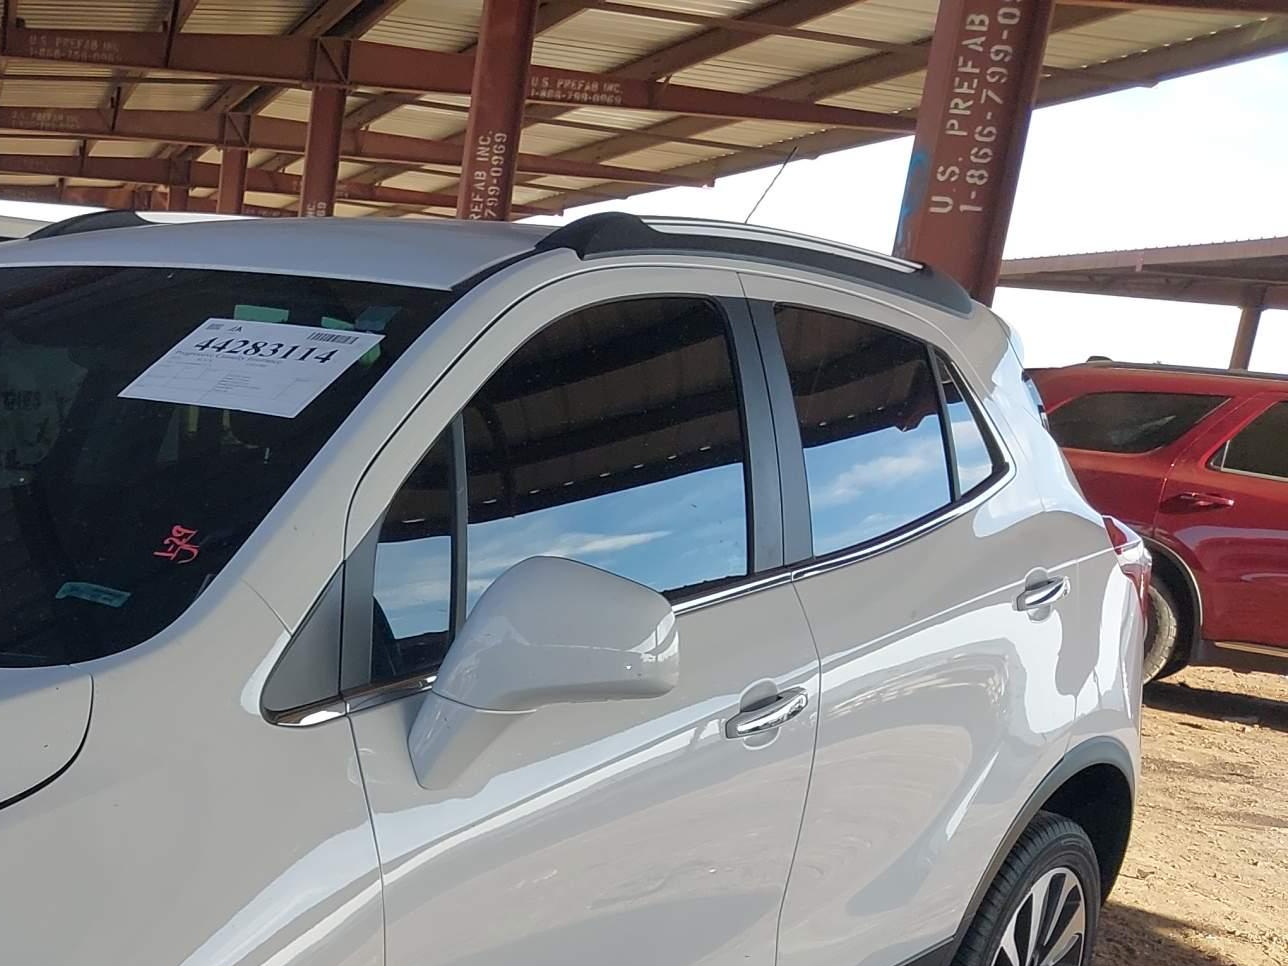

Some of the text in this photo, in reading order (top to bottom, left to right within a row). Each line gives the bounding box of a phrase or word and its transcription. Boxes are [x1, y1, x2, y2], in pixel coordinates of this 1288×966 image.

[945, 13, 990, 136] PREFAB
[959, 0, 1022, 213] 1-866-799-0
[476, 130, 492, 161] INC.
[194, 336, 339, 364] 44283114
